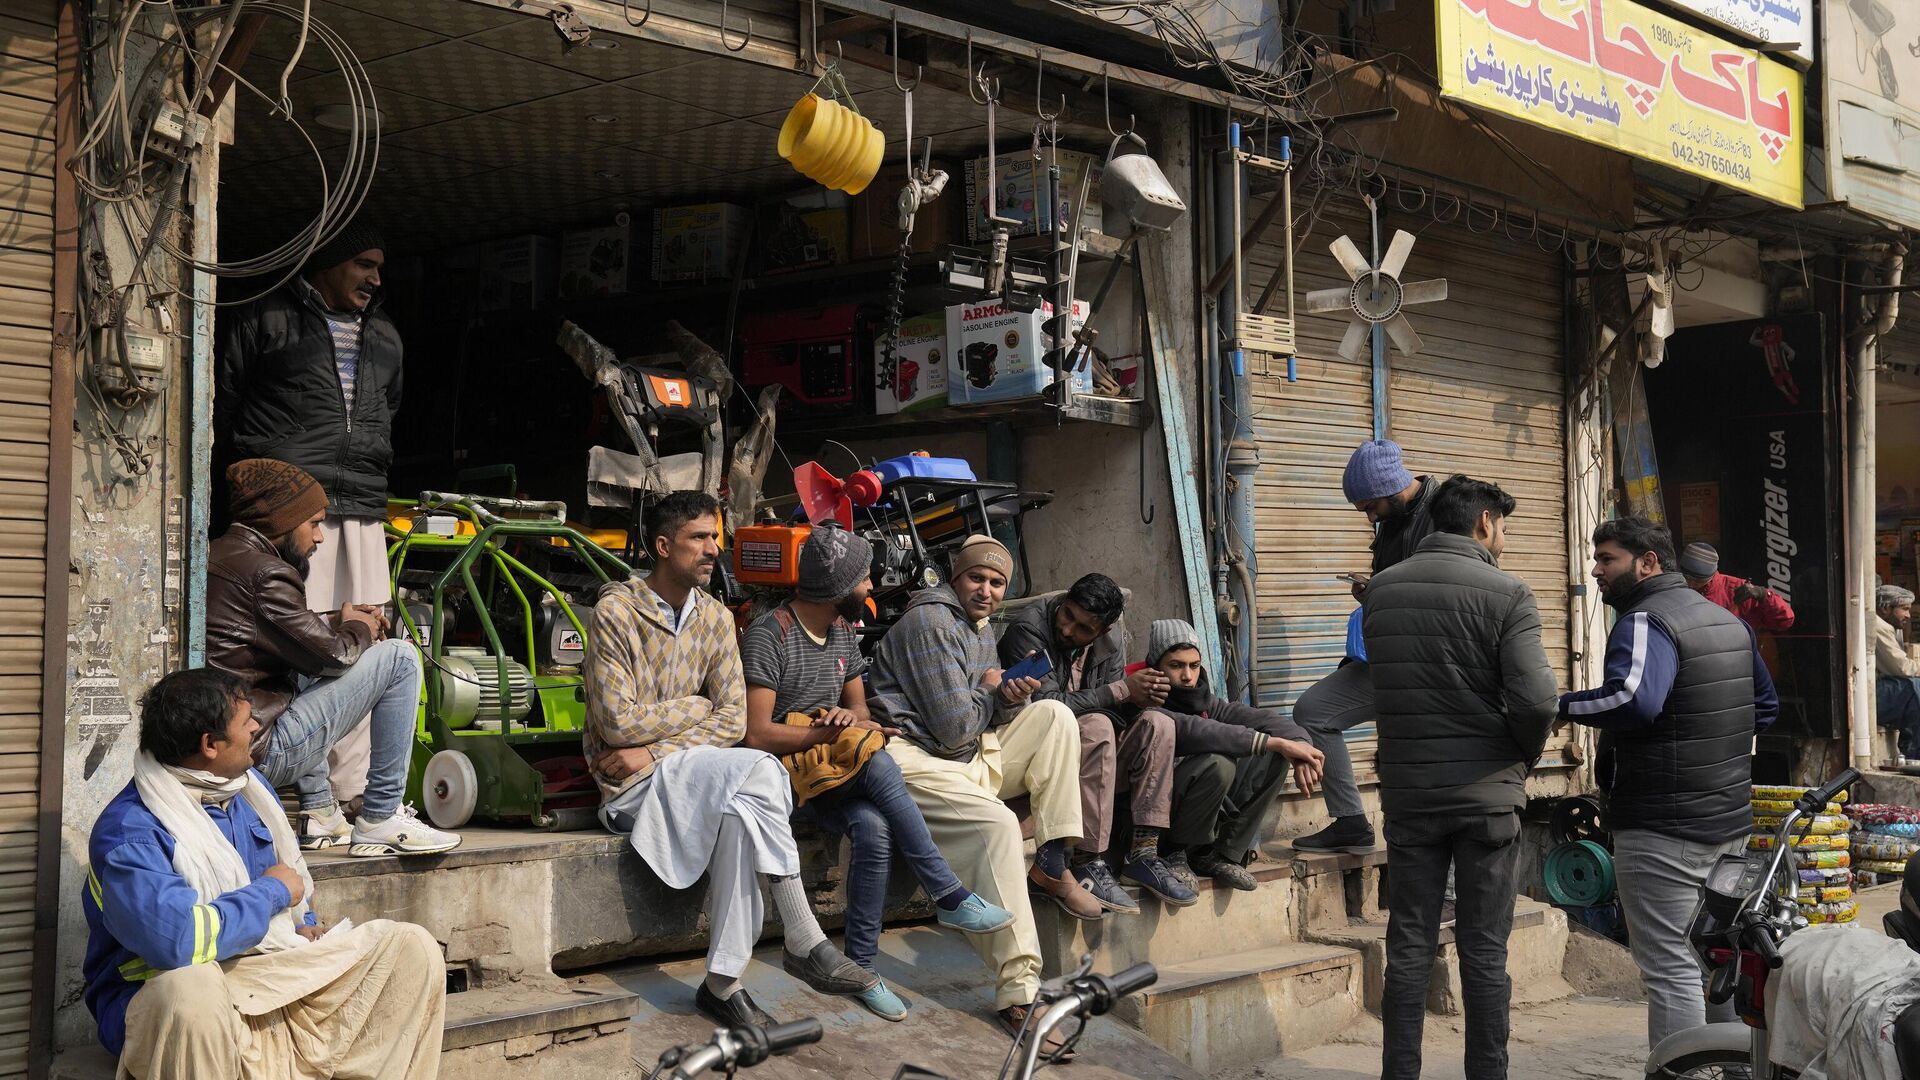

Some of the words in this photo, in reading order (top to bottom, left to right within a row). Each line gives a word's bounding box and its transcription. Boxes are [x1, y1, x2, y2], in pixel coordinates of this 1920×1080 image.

[1651, 24, 1673, 47] 1980
[1759, 27, 1770, 40] 83
[1466, 42, 1554, 109] کارپوریشن
[1554, 80, 1621, 126] مشینری
[1670, 53, 1792, 161] پاک
[1671, 140, 1752, 181] 042-37650434
[1743, 143, 1752, 159] 83
[963, 303, 1013, 321] ARMO
[994, 317, 1019, 327] ENGINE
[1768, 430, 1786, 470] USA
[1759, 477, 1798, 603] nergizer
